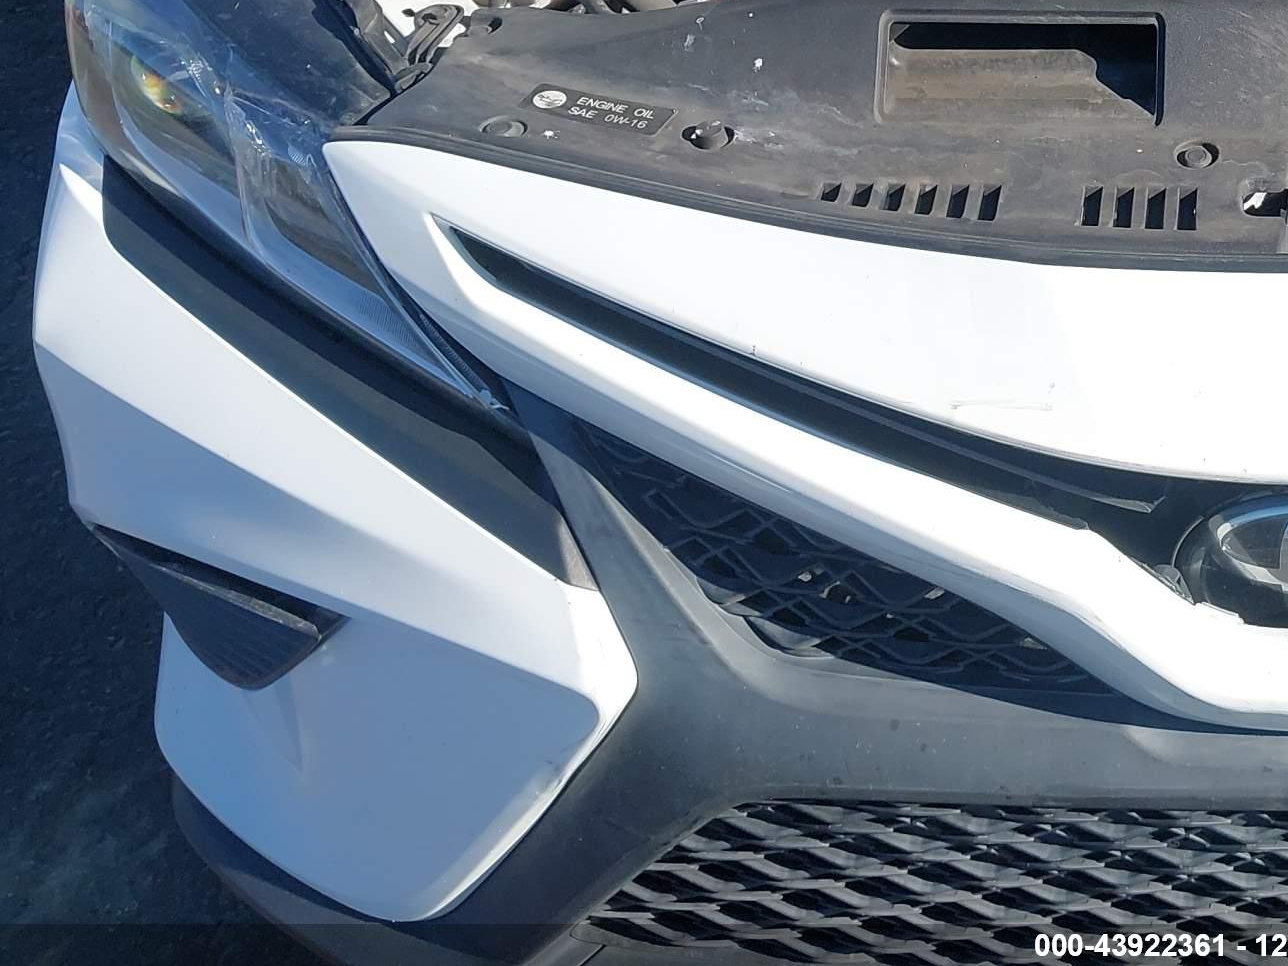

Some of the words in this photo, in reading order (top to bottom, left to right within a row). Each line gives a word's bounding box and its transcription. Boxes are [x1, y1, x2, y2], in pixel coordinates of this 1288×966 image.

[568, 106, 598, 118] SAE
[604, 114, 648, 128] 0W-16
[577, 97, 628, 113] ENGINE
[633, 108, 655, 119] OIL
